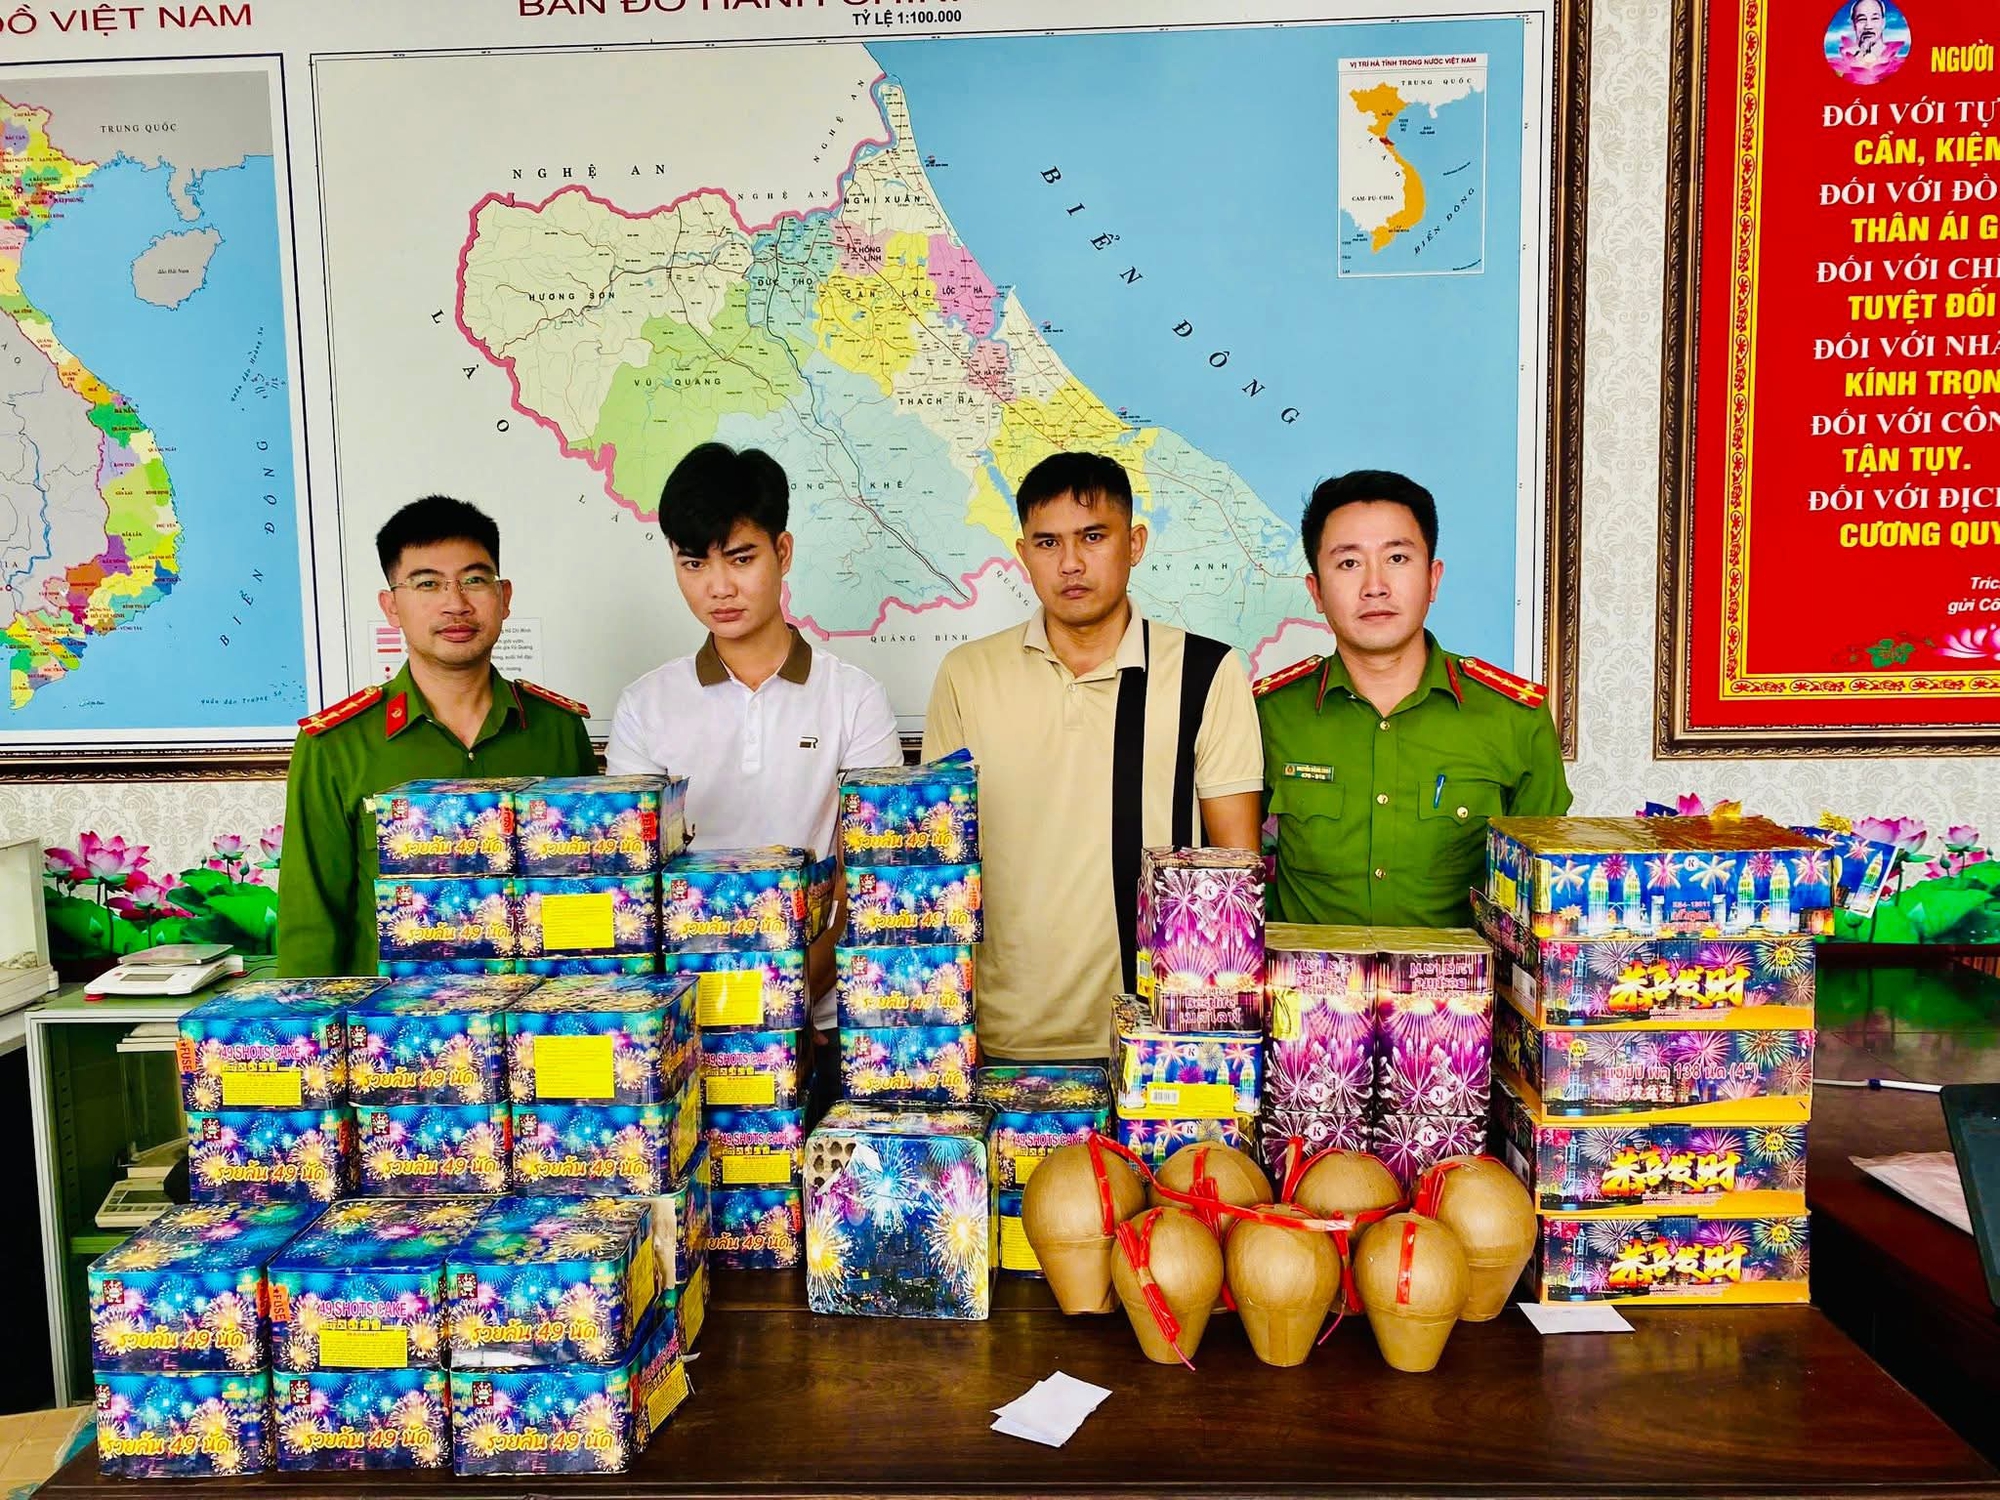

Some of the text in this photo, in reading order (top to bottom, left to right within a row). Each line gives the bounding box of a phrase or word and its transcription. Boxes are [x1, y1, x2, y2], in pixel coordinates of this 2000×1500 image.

[0, 4, 251, 36] Ồ VIỆT NAM
[852, 9, 962, 27] TỶ LỆ 1:100.000
[1399, 58, 1422, 66] TRONG
[1931, 39, 1995, 73] NGƯỜI
[1822, 96, 2000, 128] ĐỐI VỚI TỰ
[100, 121, 178, 133] TRUNG QUỐC
[812, 79, 865, 164] NGHỆ AN
[1854, 131, 1925, 166] CẦN,
[512, 162, 666, 181] NGHỆ AN
[738, 190, 829, 200] NGHỆ AN
[1819, 173, 1998, 205] ĐỐI VỚI ĐỒ
[843, 194, 922, 205] NGHI XUÂN
[1851, 210, 1999, 243] THÂN ÁI G
[1816, 253, 1938, 283] ĐỐI VỚI
[792, 277, 813, 287] THỌ
[942, 284, 983, 296] LỘC HÀ
[528, 290, 615, 302] HƯƠNG SƠN
[845, 286, 932, 299] CAN LỘC
[1040, 165, 1301, 425] BIỂN ĐÔNG
[1848, 284, 1995, 324] TUYỆT ĐỐI
[1813, 331, 1935, 359] ĐỐI VỚI
[674, 377, 722, 387] QUANG
[1845, 367, 1917, 397] KÍNH
[1811, 409, 1867, 436] ĐỐI
[1876, 407, 1932, 434] VỚI
[1842, 443, 1971, 477] TẬN TỤY.
[870, 480, 903, 489] KHÊ
[1808, 484, 1864, 511] ĐỐI
[1873, 482, 1929, 509] VỚI
[1839, 520, 1940, 548] CƯƠNG
[219, 440, 279, 647] BIỂN ĐÔNG
[1194, 562, 1229, 571] ANH
[1947, 599, 1976, 614] gửi
[870, 633, 917, 643] QUẢNG
[456, 838, 478, 854] 49
[594, 838, 616, 854] 49
[460, 923, 483, 940] 49
[179, 1046, 193, 1071] FUSE
[221, 1044, 302, 1061] 49 SHOTS CAKE
[420, 1069, 444, 1087] 49
[1674, 1062, 1702, 1080] 138
[1027, 1132, 1059, 1147] SHOTS
[1312, 1126, 1322, 1137] K
[1423, 1132, 1433, 1143] K
[272, 1163, 297, 1182] 49
[441, 1158, 466, 1176] 49
[590, 1158, 616, 1177] 49
[274, 1294, 287, 1321] FUSE
[319, 1301, 407, 1318] 49 SHOTS CAKE
[183, 1329, 211, 1350] 49
[537, 1322, 564, 1341] 49
[169, 1436, 197, 1455] 49
[369, 1429, 397, 1449] 49
[552, 1431, 580, 1449] 49
